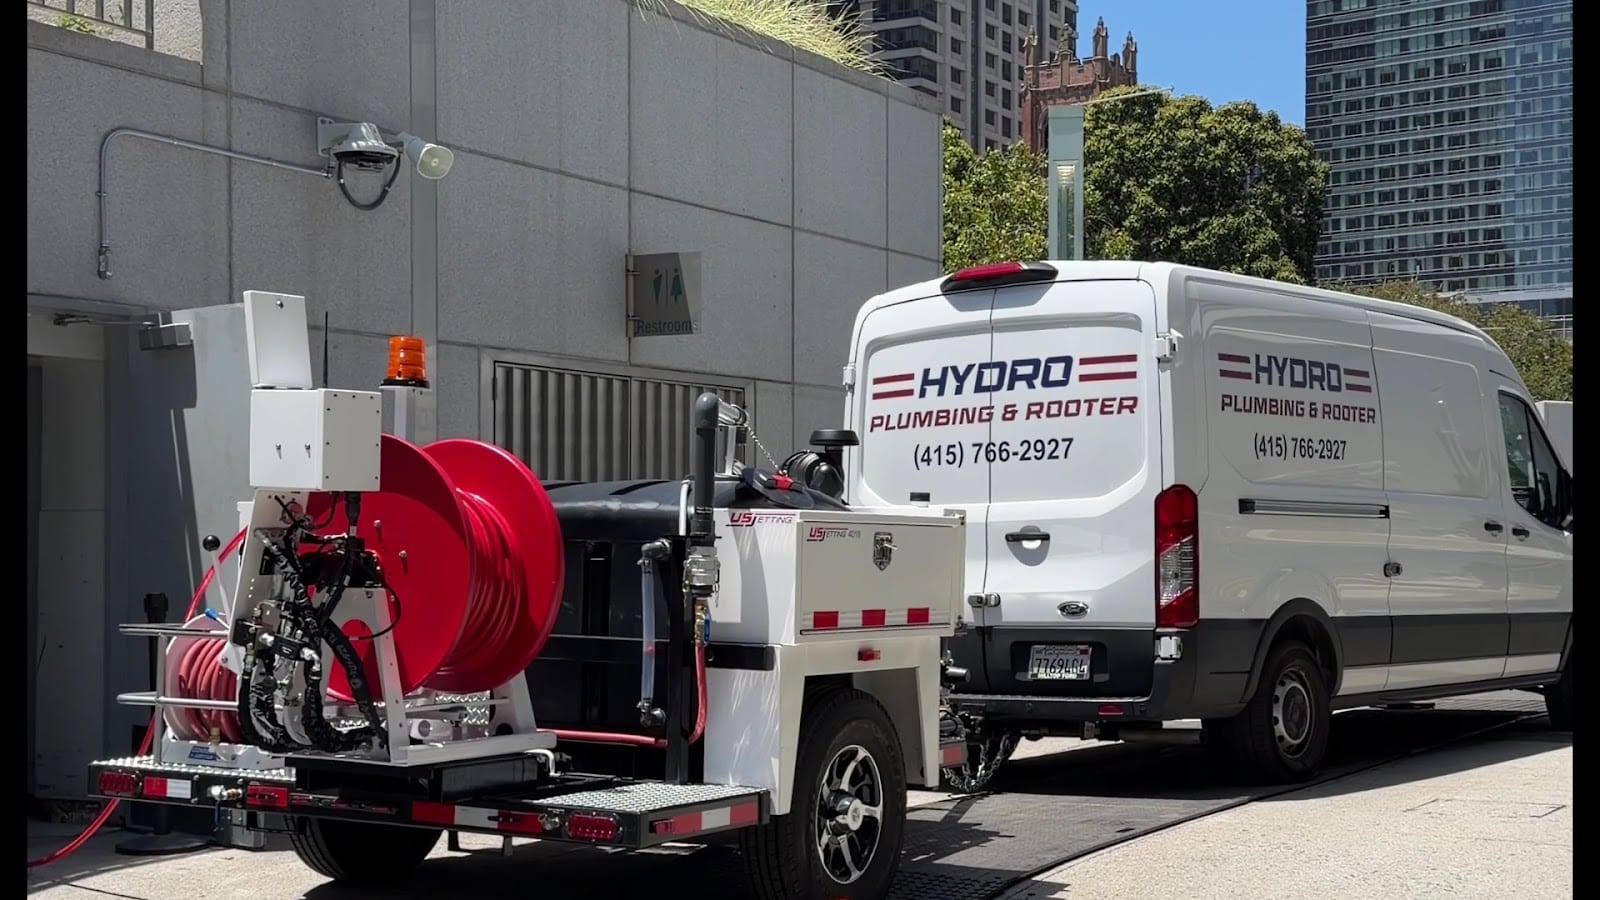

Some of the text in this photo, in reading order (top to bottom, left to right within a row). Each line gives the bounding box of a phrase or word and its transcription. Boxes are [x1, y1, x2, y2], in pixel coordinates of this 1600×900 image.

[919, 355, 1073, 398] HYDRO
[1255, 354, 1342, 392] HYDRO
[870, 396, 1139, 432] PLUMBING & ROOTER
[1221, 394, 1376, 424] PLUMBING & ROOTER
[914, 438, 1074, 470] (415) 766-2927
[1254, 433, 1347, 460] (415) 766-2927
